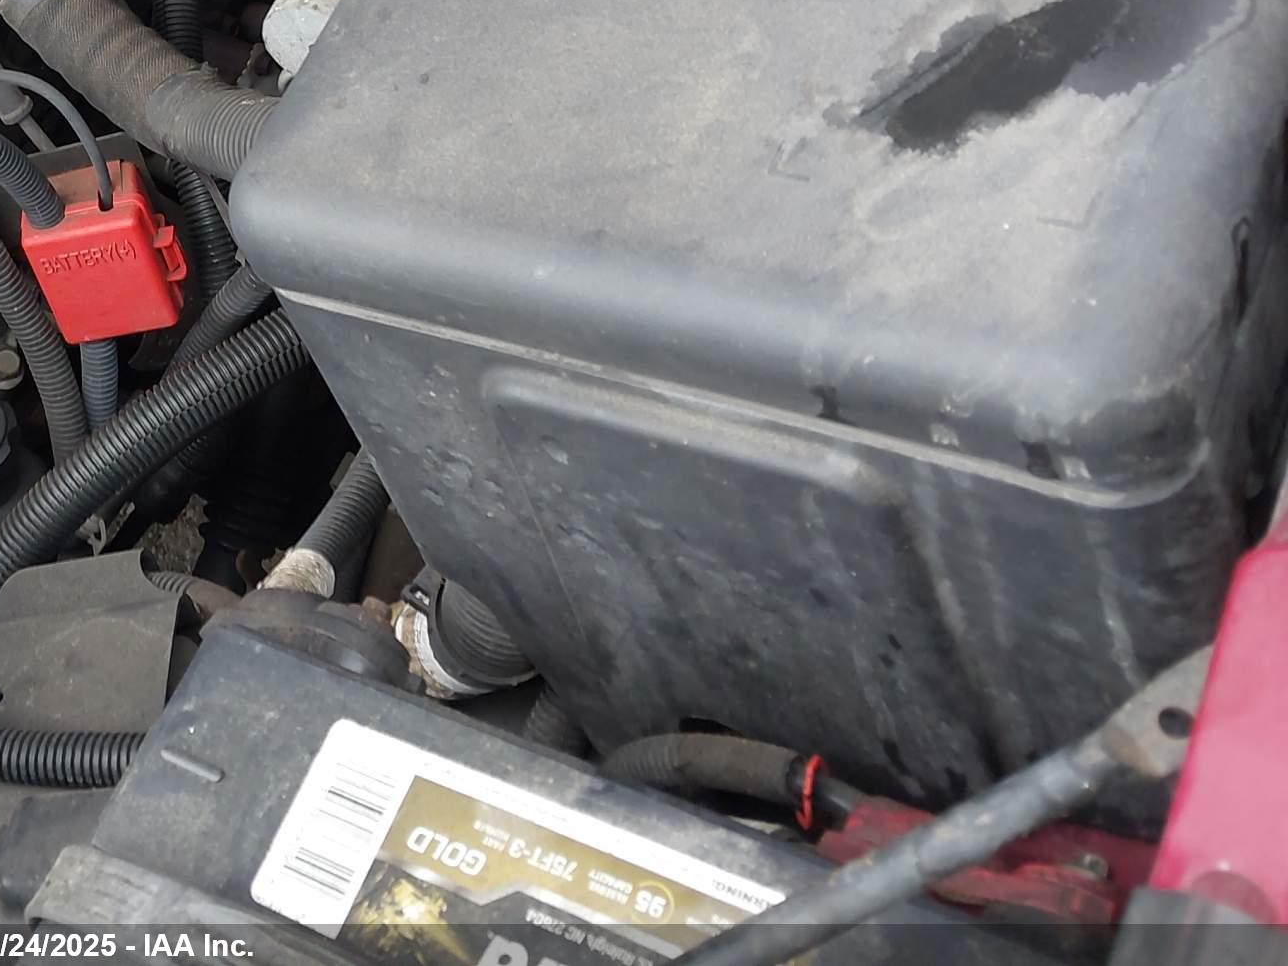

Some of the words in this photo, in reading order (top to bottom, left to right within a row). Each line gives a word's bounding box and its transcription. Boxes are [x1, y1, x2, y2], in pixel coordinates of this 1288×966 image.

[39, 239, 137, 276] BATTERY(+)
[406, 825, 488, 876] GOLD
[508, 837, 579, 882] 75FT-3
[634, 889, 667, 919] 95
[563, 926, 587, 946] NC
